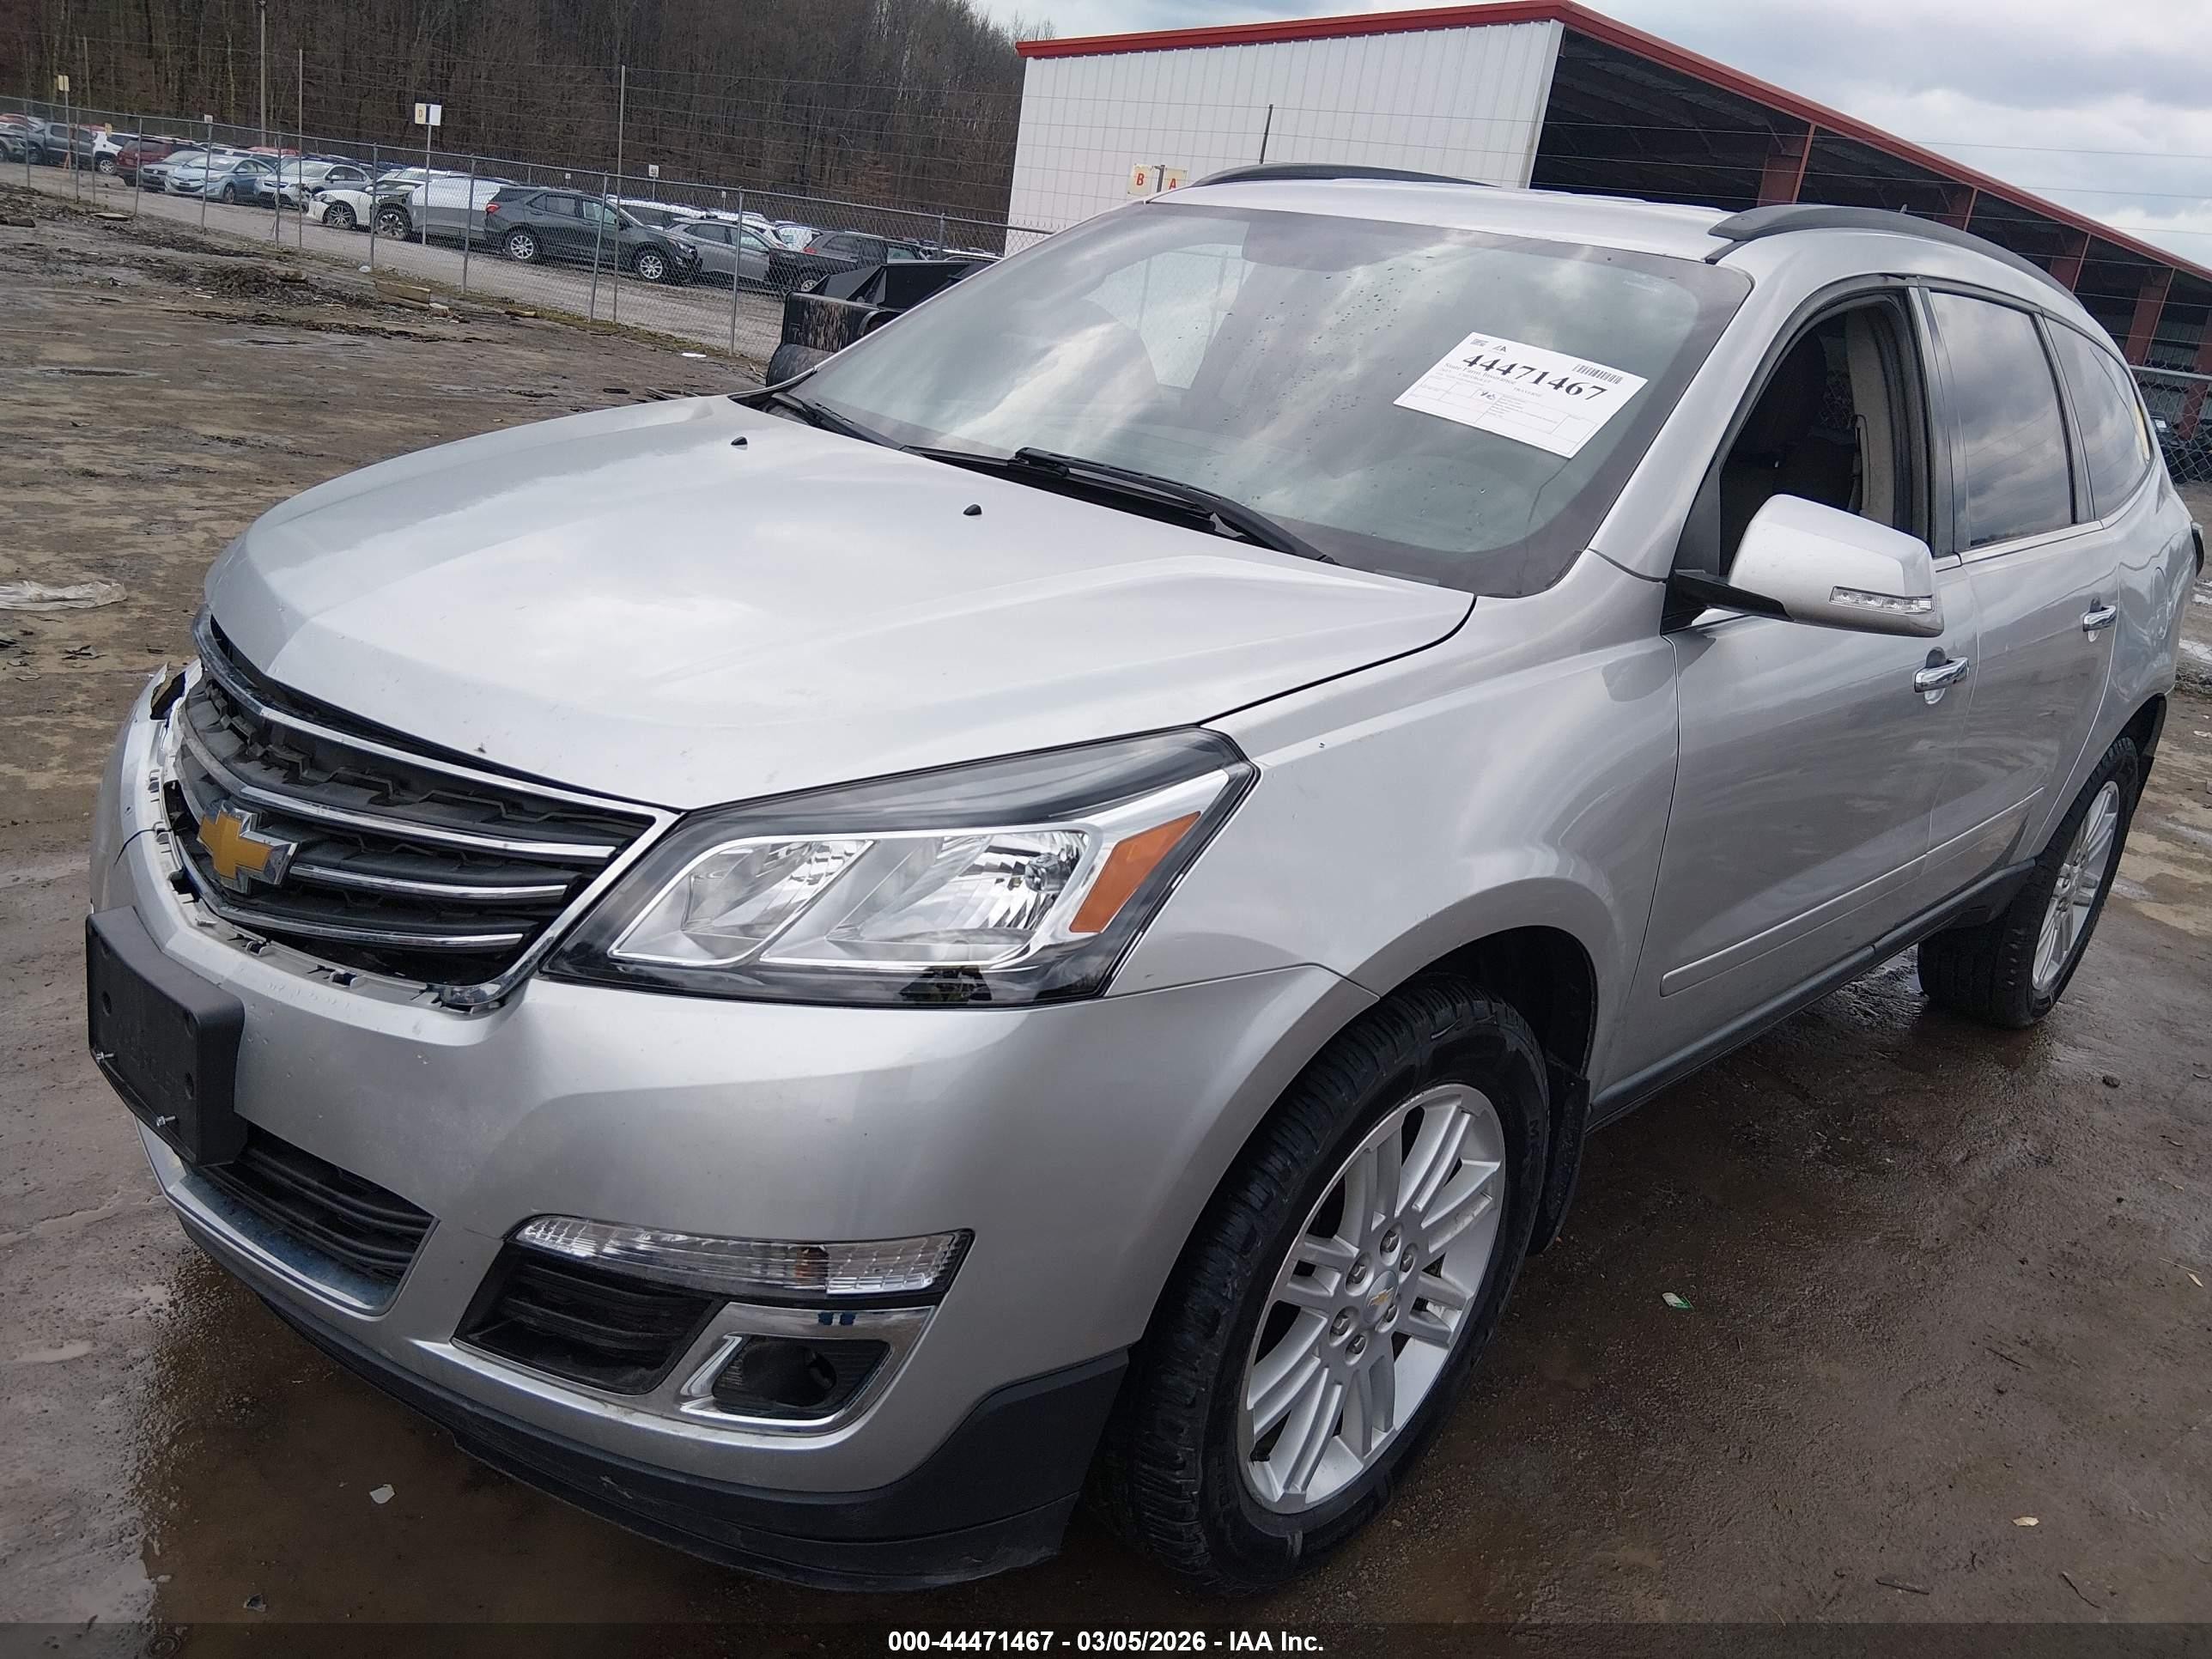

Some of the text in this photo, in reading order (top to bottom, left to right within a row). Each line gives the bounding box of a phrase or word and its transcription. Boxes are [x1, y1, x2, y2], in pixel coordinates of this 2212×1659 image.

[418, 109, 423, 118] D
[1136, 173, 1145, 185] B
[1169, 178, 1176, 190] A
[1462, 355, 1607, 400] 44471467
